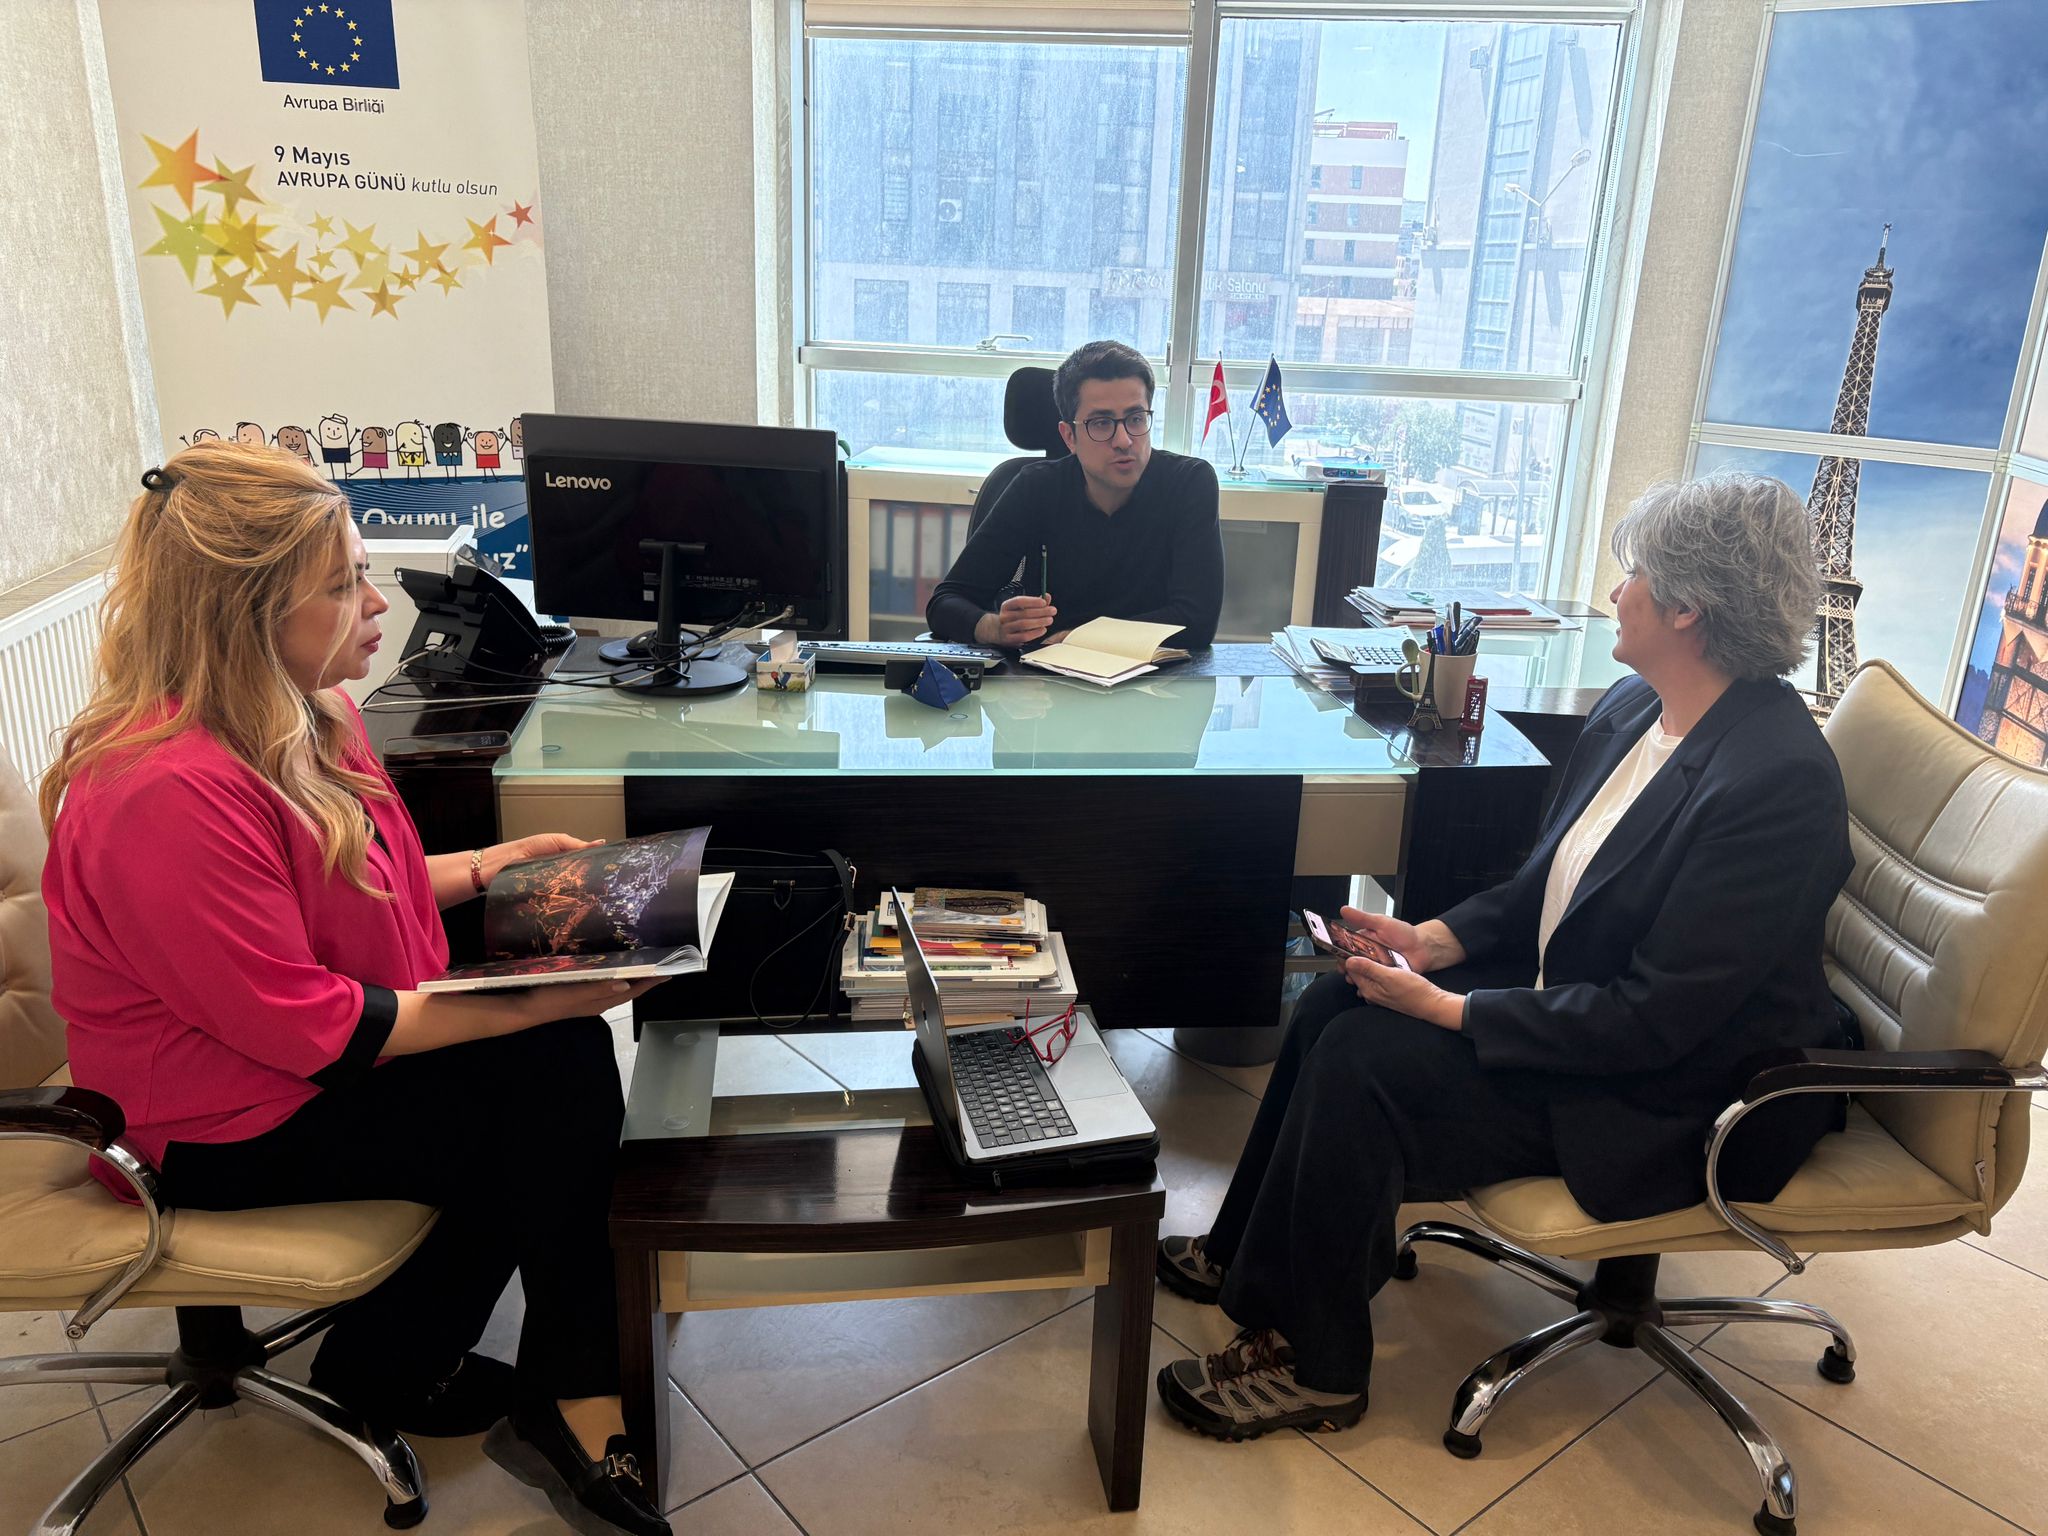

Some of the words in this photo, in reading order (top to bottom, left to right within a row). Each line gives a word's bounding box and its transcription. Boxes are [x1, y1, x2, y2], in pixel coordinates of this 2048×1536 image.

[283, 93, 338, 112] Avrupa
[343, 97, 385, 115] Birliği
[274, 145, 285, 163] 9
[292, 147, 350, 168] Mayıs
[277, 171, 350, 189] AVRUPA
[354, 173, 405, 191] GÜNÜ
[411, 177, 451, 194] kutlu
[456, 179, 498, 196] olsun
[1227, 277, 1266, 294] Salonu
[545, 471, 612, 491] Lenovo
[472, 504, 506, 529] ile
